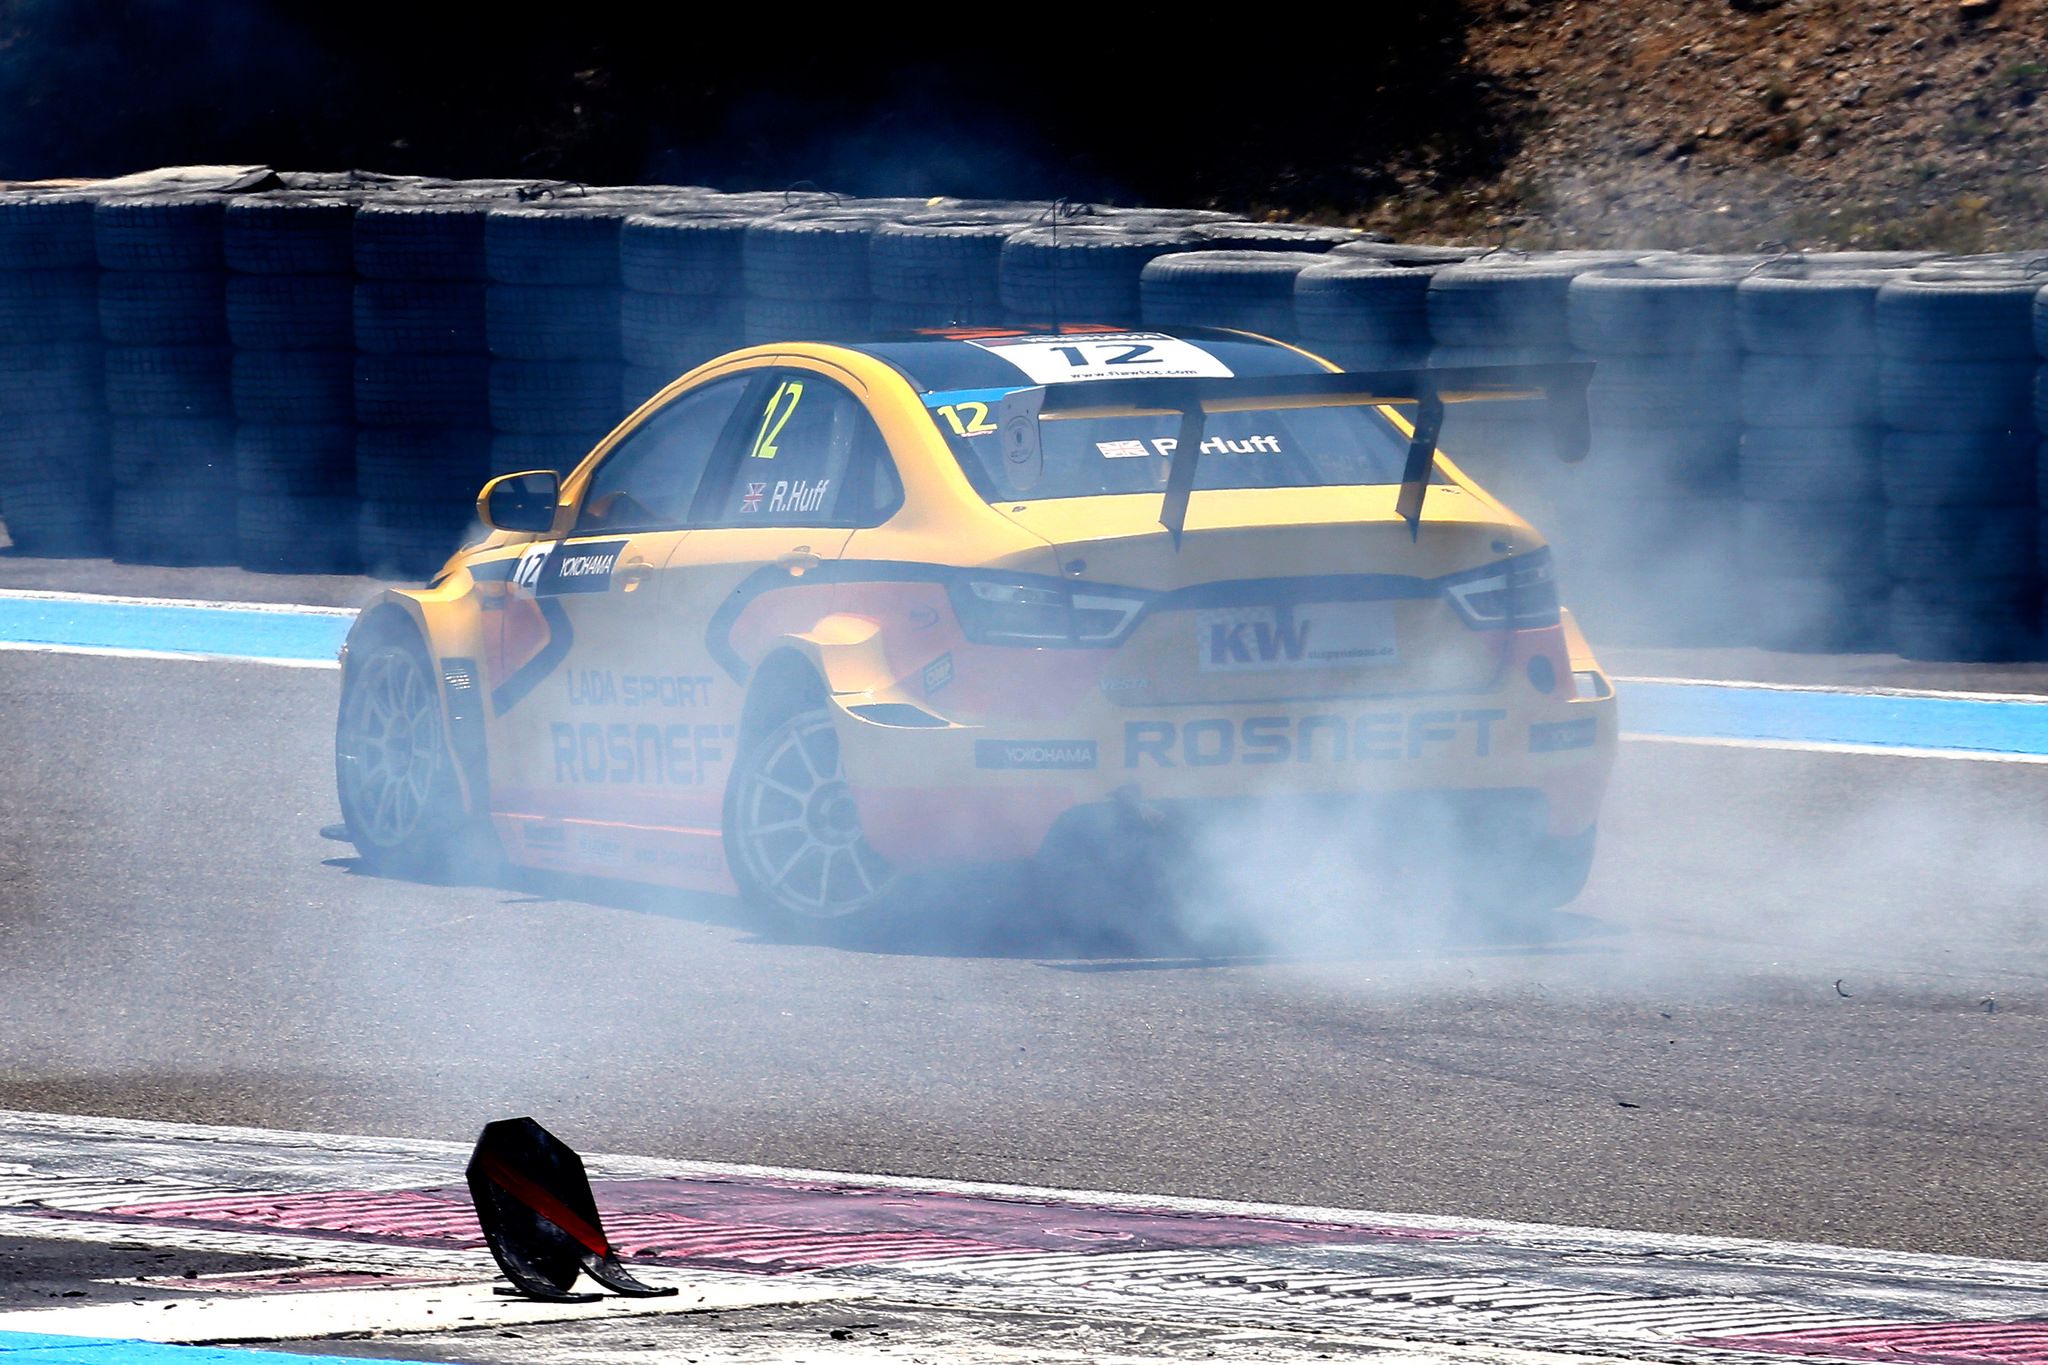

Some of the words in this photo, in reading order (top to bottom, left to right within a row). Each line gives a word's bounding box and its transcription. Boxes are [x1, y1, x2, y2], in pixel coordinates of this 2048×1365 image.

[1049, 344, 1164, 366] 12
[751, 380, 804, 459] 12
[937, 401, 998, 435] 12
[1200, 436, 1281, 455] Huff
[769, 479, 831, 513] R.Huff
[518, 552, 546, 588] 12
[559, 554, 614, 577] YOKOHAMA
[1210, 618, 1310, 664] KW
[567, 669, 616, 707] LADA
[622, 675, 713, 707] SPORT
[550, 722, 735, 785] ROSNEF
[1005, 747, 1092, 763] YOKOHAMA
[1123, 708, 1506, 769] ROSNEFT
